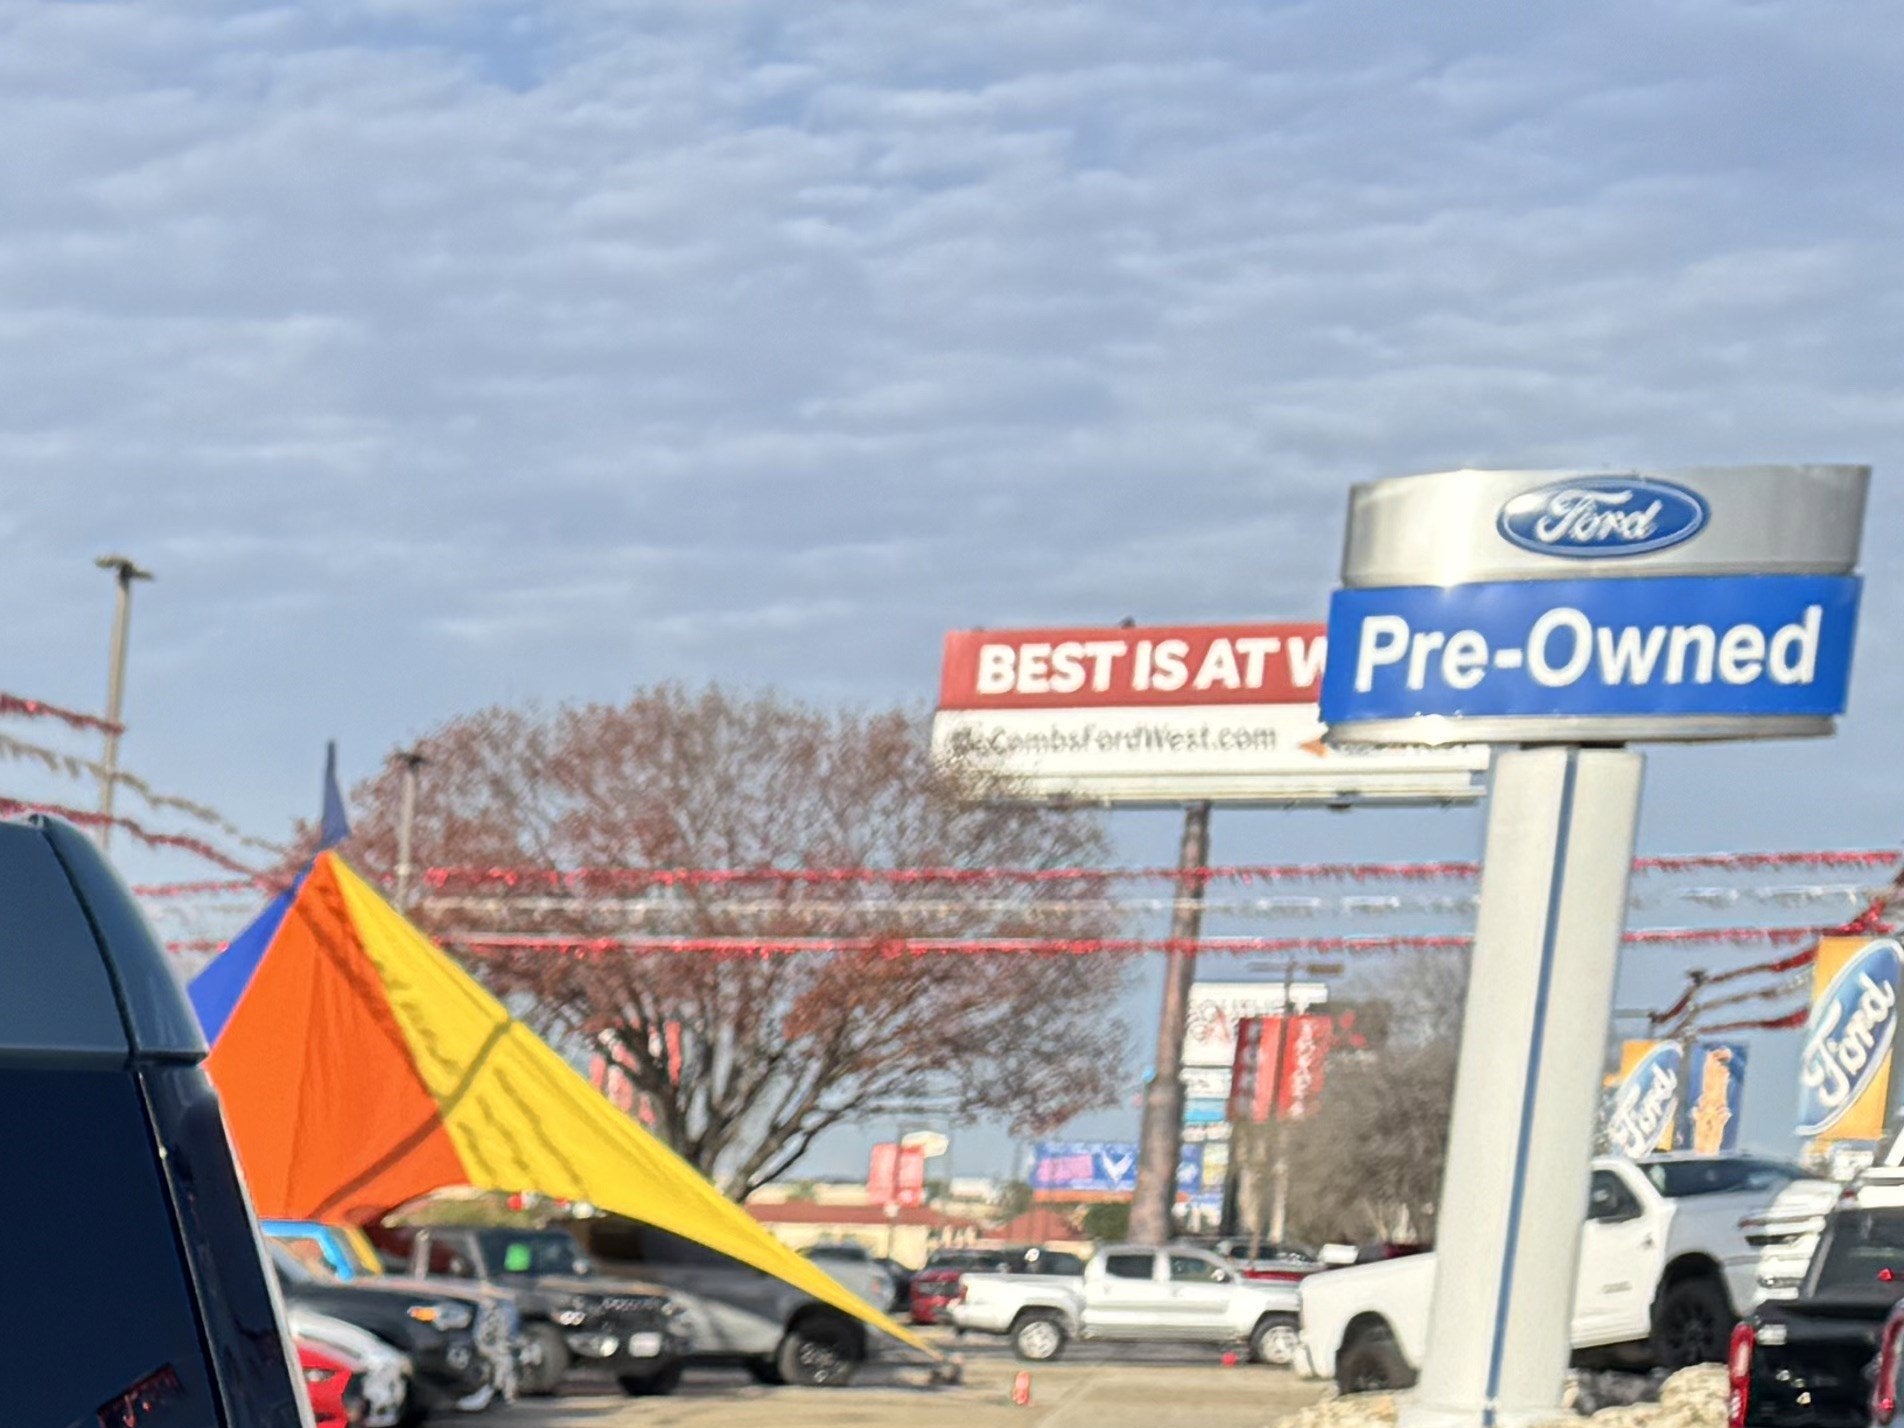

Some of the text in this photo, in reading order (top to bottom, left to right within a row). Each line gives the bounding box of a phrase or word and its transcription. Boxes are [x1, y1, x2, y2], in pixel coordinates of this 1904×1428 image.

[1535, 489, 1663, 543] Ford
[975, 639, 1126, 694] BEST
[1131, 636, 1190, 691] IS
[1193, 636, 1281, 690] AT
[1353, 605, 1823, 692] Pre-Owned
[1802, 970, 1895, 1107] Ford
